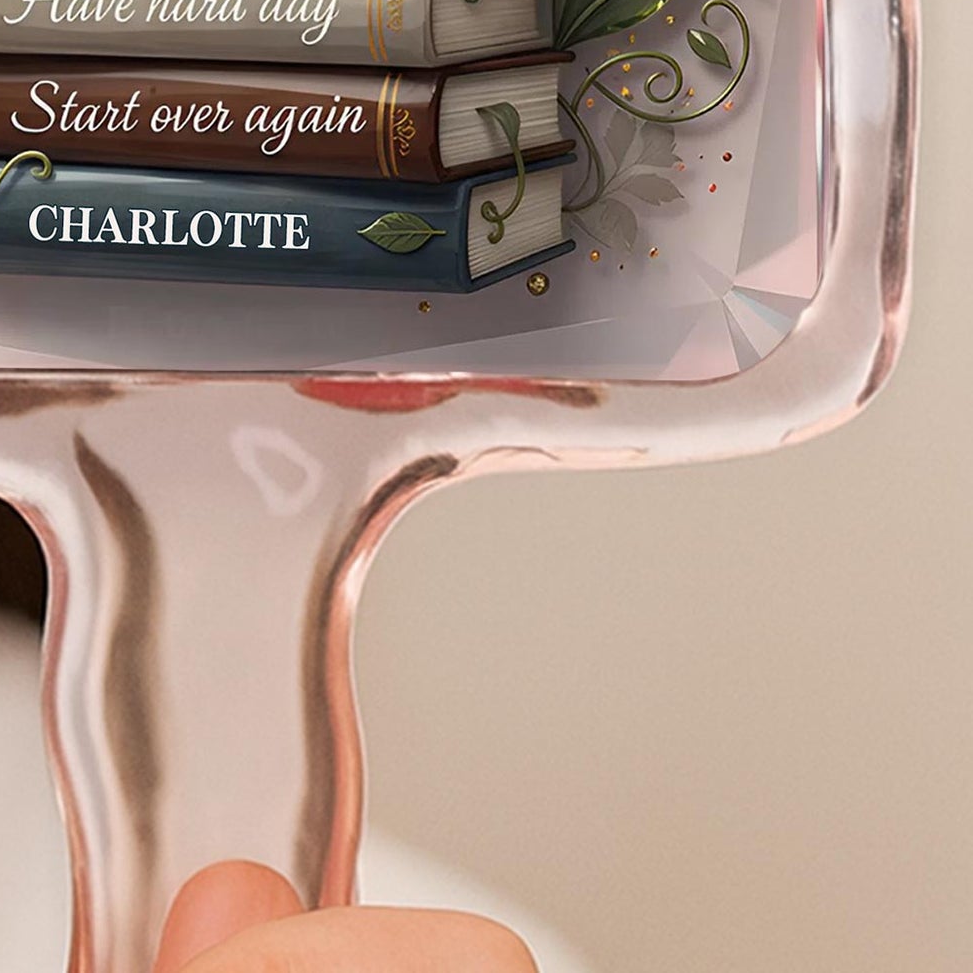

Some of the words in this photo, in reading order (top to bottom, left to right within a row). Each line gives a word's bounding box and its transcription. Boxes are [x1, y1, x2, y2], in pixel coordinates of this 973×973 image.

[11, 80, 138, 133] Start
[150, 99, 233, 132] over
[245, 94, 366, 154] again
[28, 204, 311, 250] CHARLOTTE
